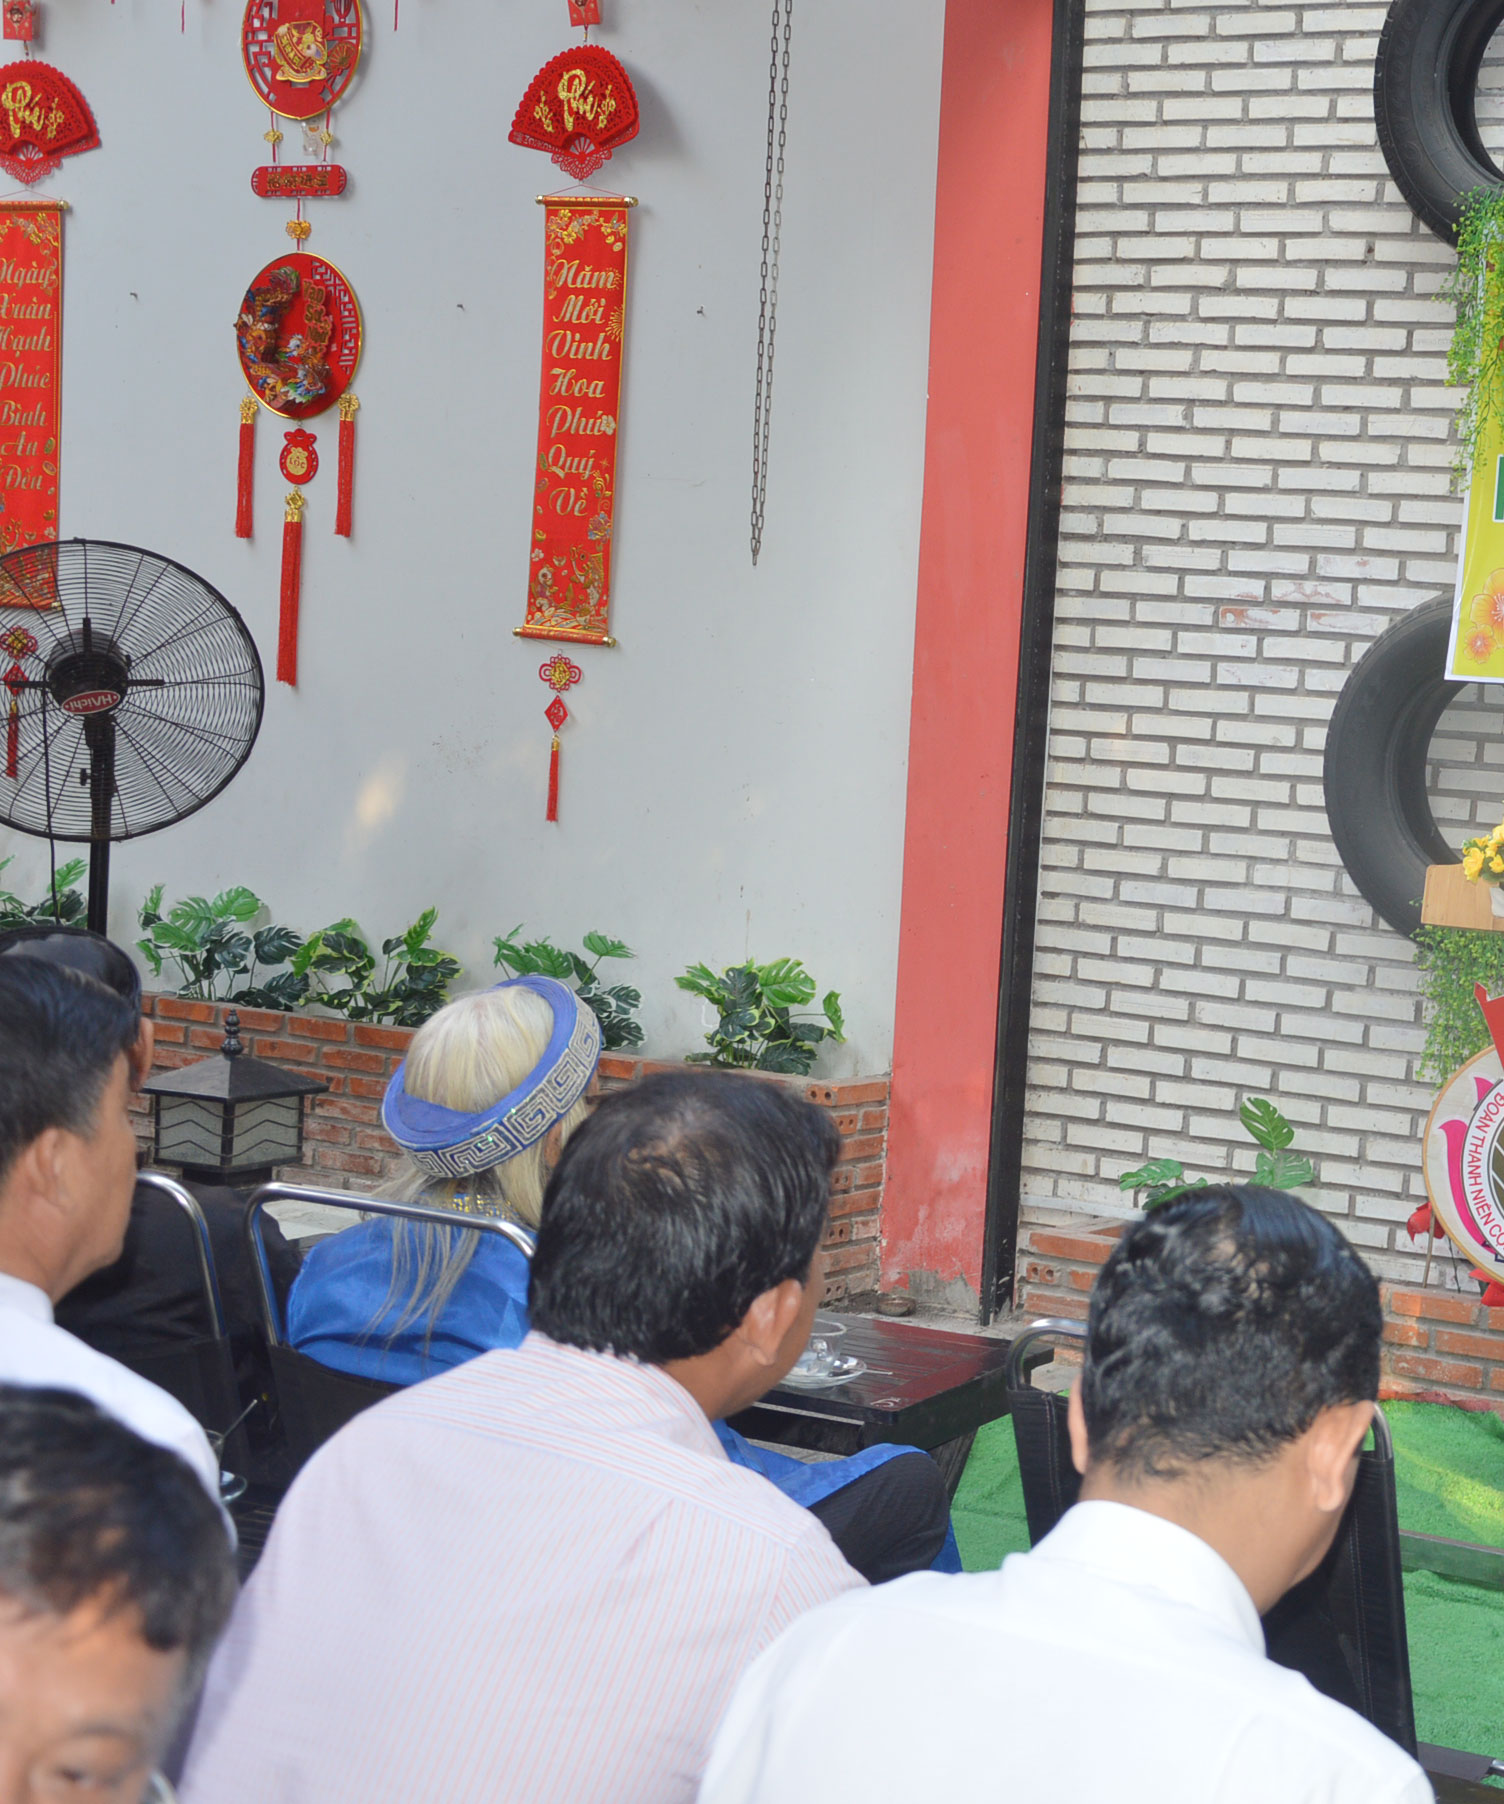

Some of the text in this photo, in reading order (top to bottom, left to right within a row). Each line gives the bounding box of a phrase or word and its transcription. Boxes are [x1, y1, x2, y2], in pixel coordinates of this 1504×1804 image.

[2, 81, 45, 138] Phú
[558, 69, 598, 131] Phú
[550, 259, 617, 288] Năm
[552, 294, 606, 324] Mới
[546, 329, 613, 361] Vinh
[0, 361, 51, 391] Phúc
[549, 367, 606, 398] Hoa
[1, 400, 47, 427] Bình
[546, 405, 604, 438] Phú
[0, 431, 38, 456] An
[0, 464, 43, 490] Đến
[547, 443, 596, 480] Quý
[1467, 1134, 1486, 1186] THANH
[1470, 1189, 1496, 1227] NIÊN
